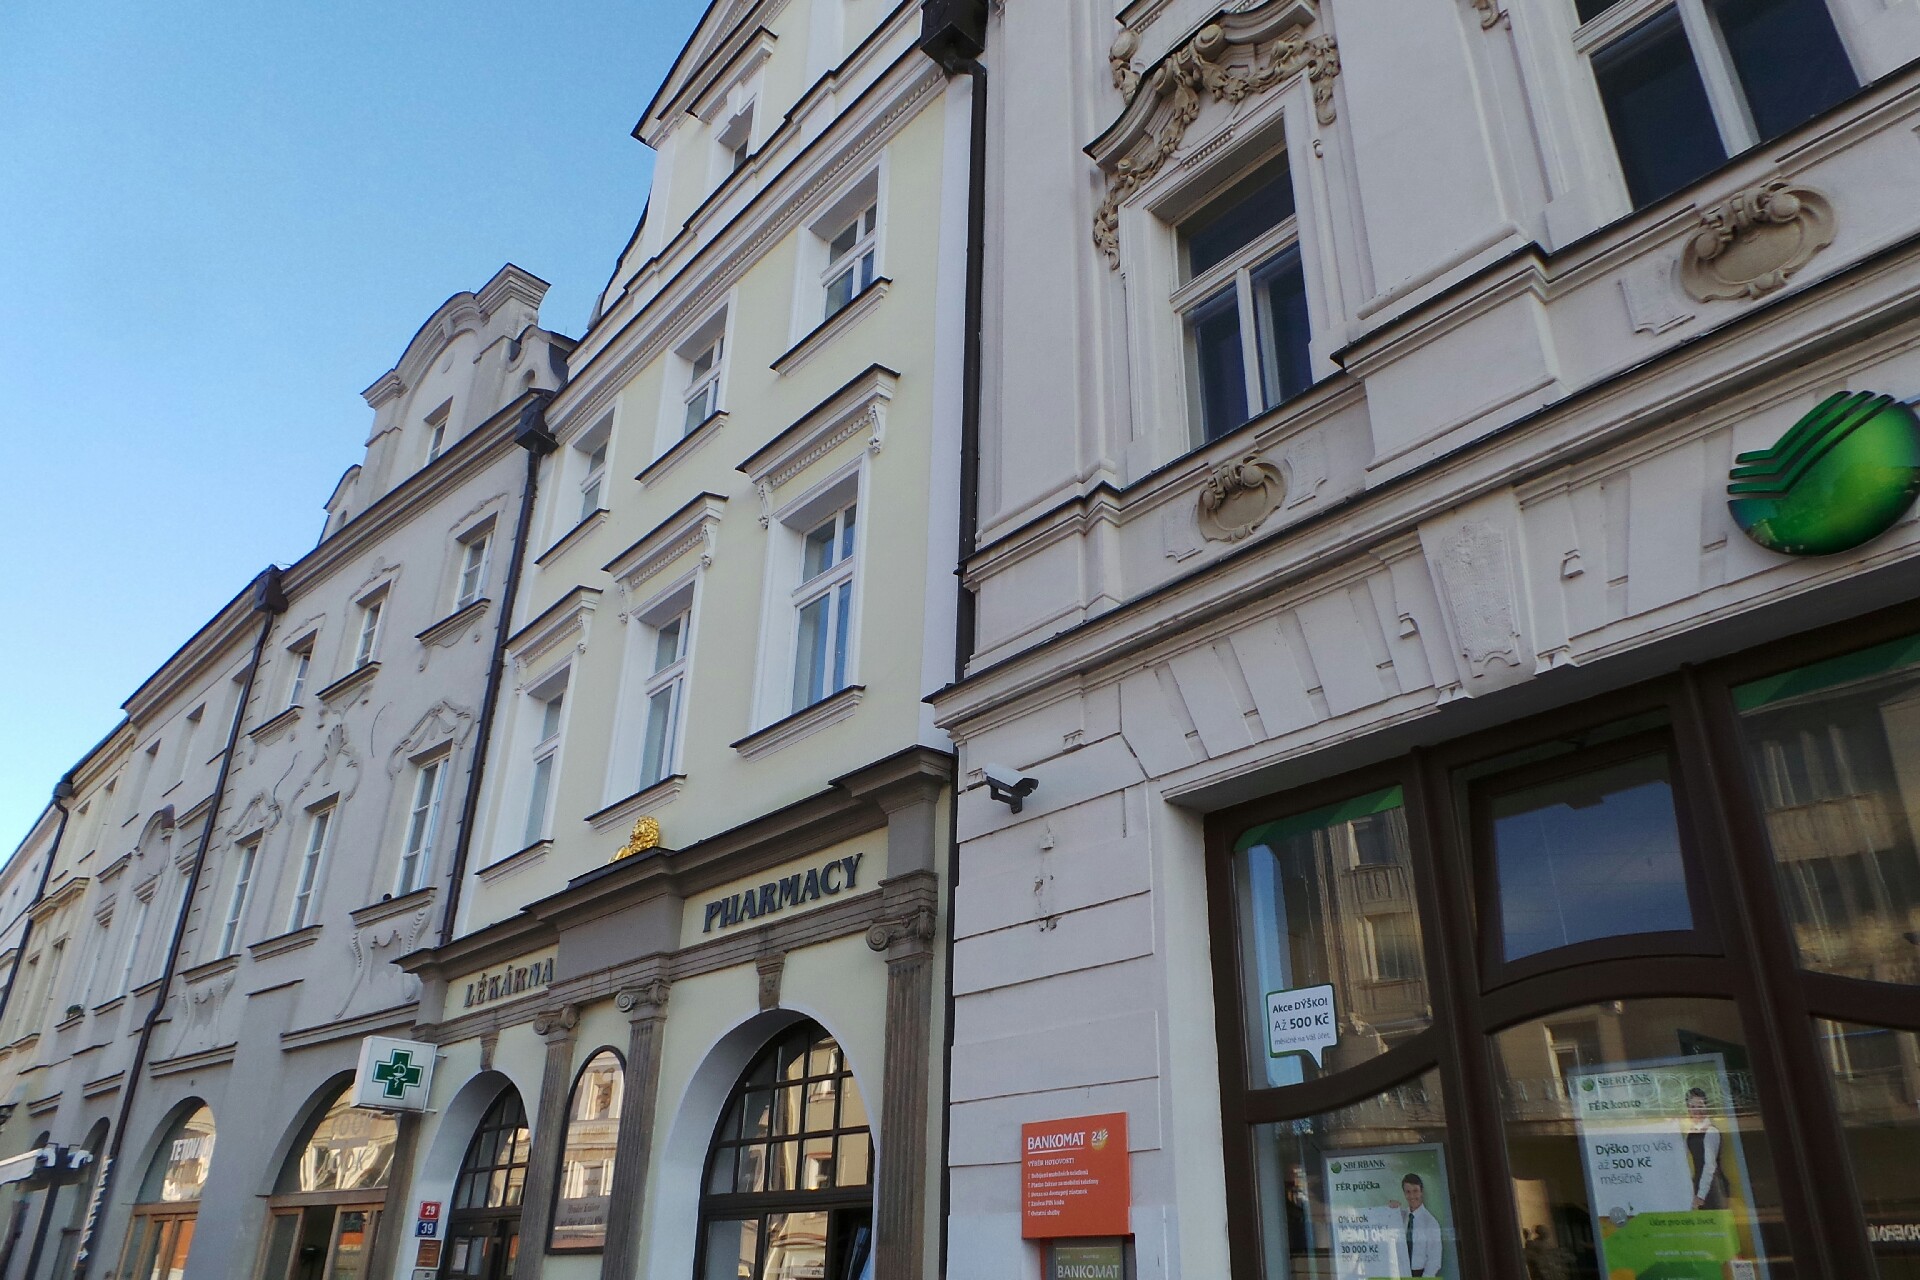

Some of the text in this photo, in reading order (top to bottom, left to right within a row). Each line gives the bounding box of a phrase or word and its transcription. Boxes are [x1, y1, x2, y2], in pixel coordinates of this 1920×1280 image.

[703, 853, 863, 933] PHARMACY
[463, 957, 553, 1008] LÉKÁRNA
[1273, 998, 1328, 1013] Akce DÝŠKO!
[1274, 1012, 1329, 1031] Až 500 Kč
[1598, 1073, 1651, 1086] SBERBANK
[1611, 1099, 1642, 1109] konto
[1027, 1132, 1085, 1150] BANKOMAT
[1596, 1141, 1673, 1156] Dýško pro Vás
[1343, 1159, 1385, 1169] SBERBANK
[1598, 1156, 1652, 1170] až 500 Kč
[1601, 1173, 1643, 1184] měsíčně
[1336, 1180, 1380, 1192] FÉR půjčka
[425, 1206, 435, 1216] 29
[1351, 1214, 1368, 1223] úrok
[421, 1223, 433, 1234] 39
[1341, 1244, 1379, 1254] 30 000 Kč
[1057, 1264, 1119, 1278] BANKOMAT
